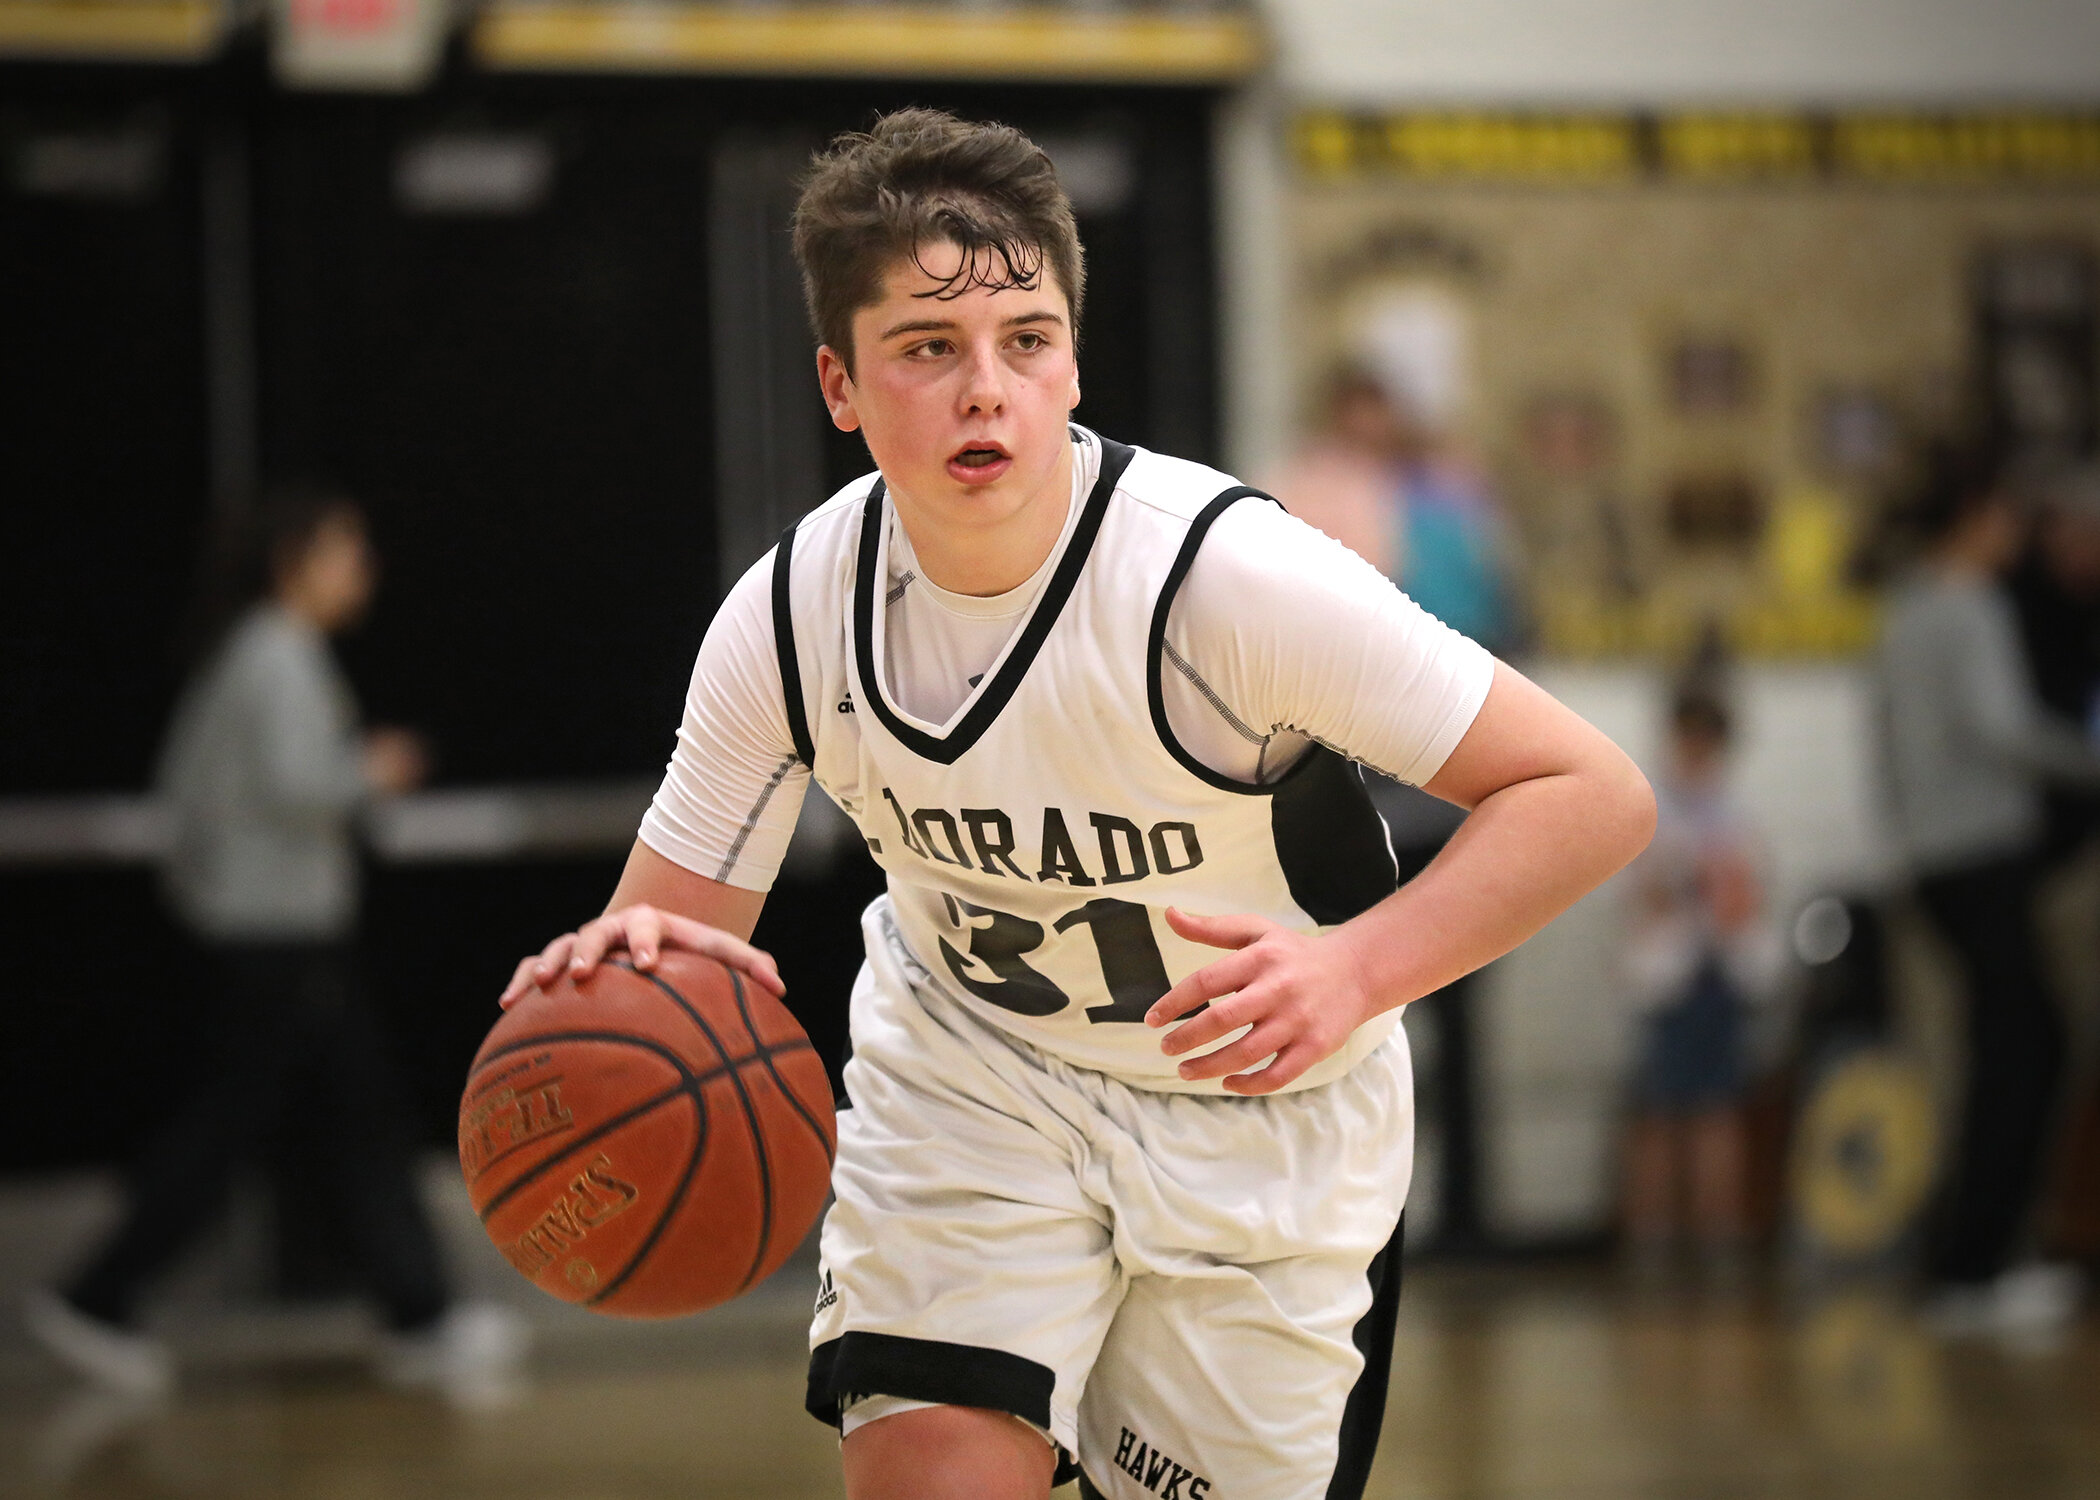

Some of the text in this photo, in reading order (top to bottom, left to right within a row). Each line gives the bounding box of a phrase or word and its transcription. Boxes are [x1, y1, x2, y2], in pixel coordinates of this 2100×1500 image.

[937, 892, 1210, 1025] 31
[506, 1152, 639, 1278] SPALD
[1113, 1426, 1212, 1500] HAWKS
